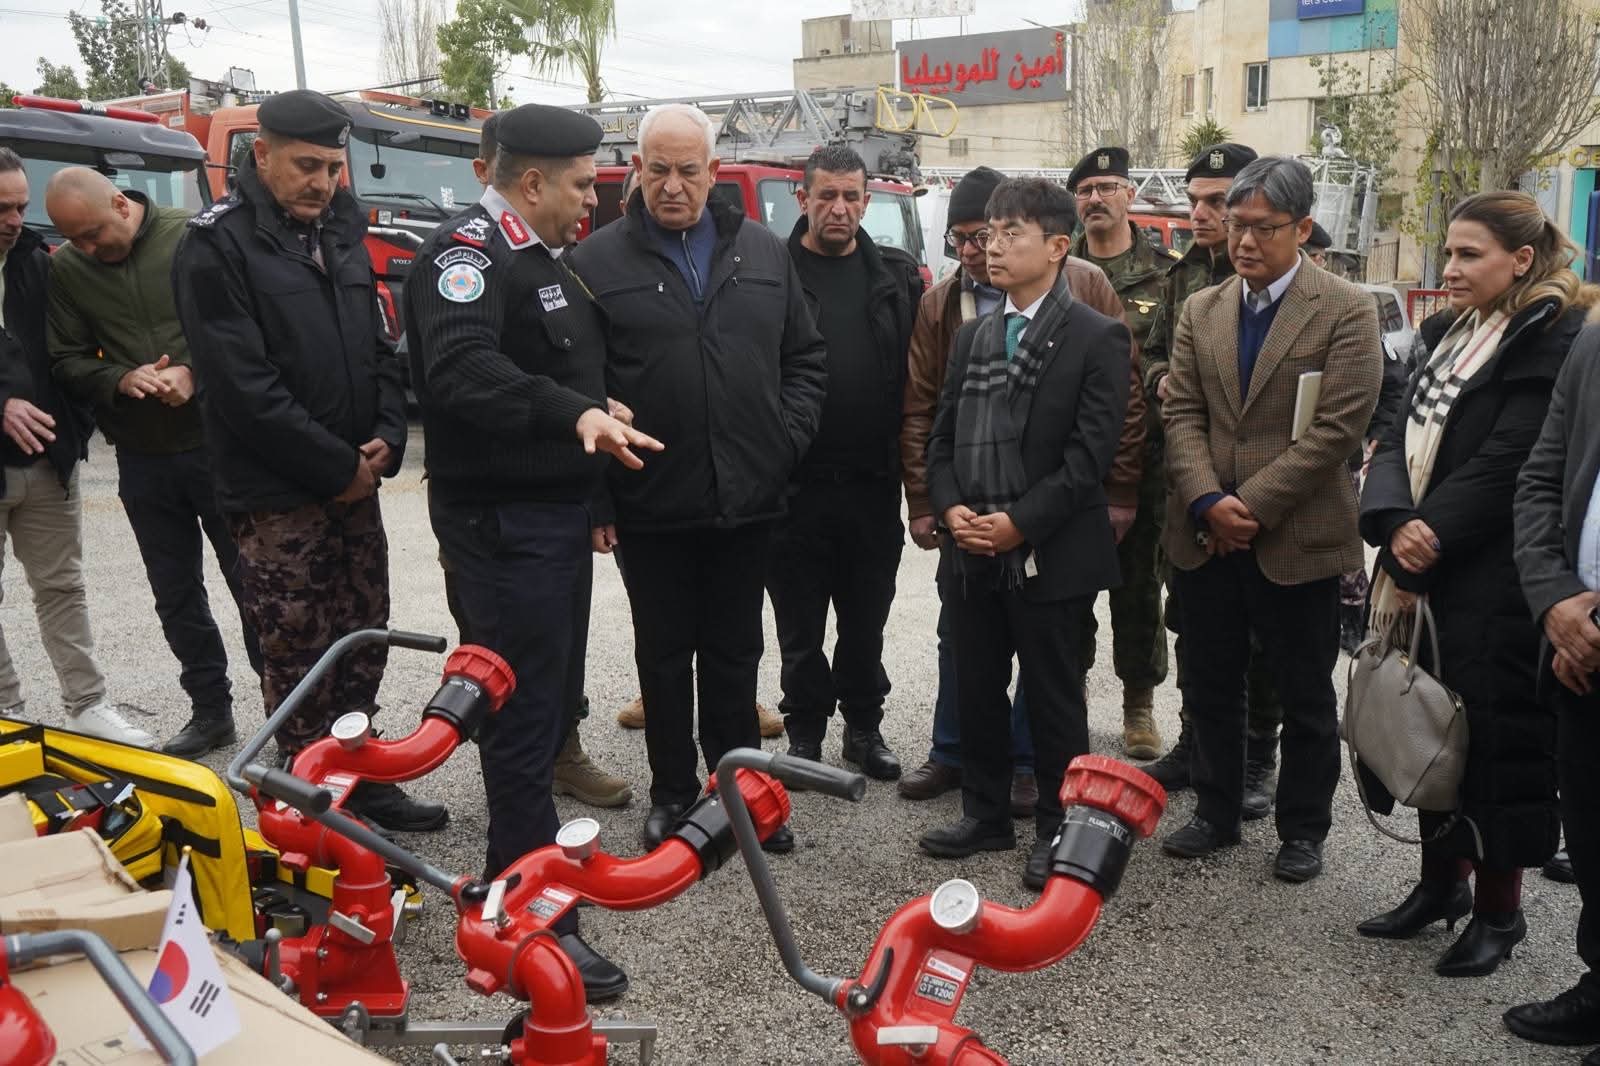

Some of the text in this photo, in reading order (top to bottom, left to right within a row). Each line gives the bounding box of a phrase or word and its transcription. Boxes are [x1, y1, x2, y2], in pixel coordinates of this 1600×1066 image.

[902, 32, 1064, 95] أمين للموبيليا
[919, 982, 934, 993] GT
[934, 986, 954, 1000] 1200
